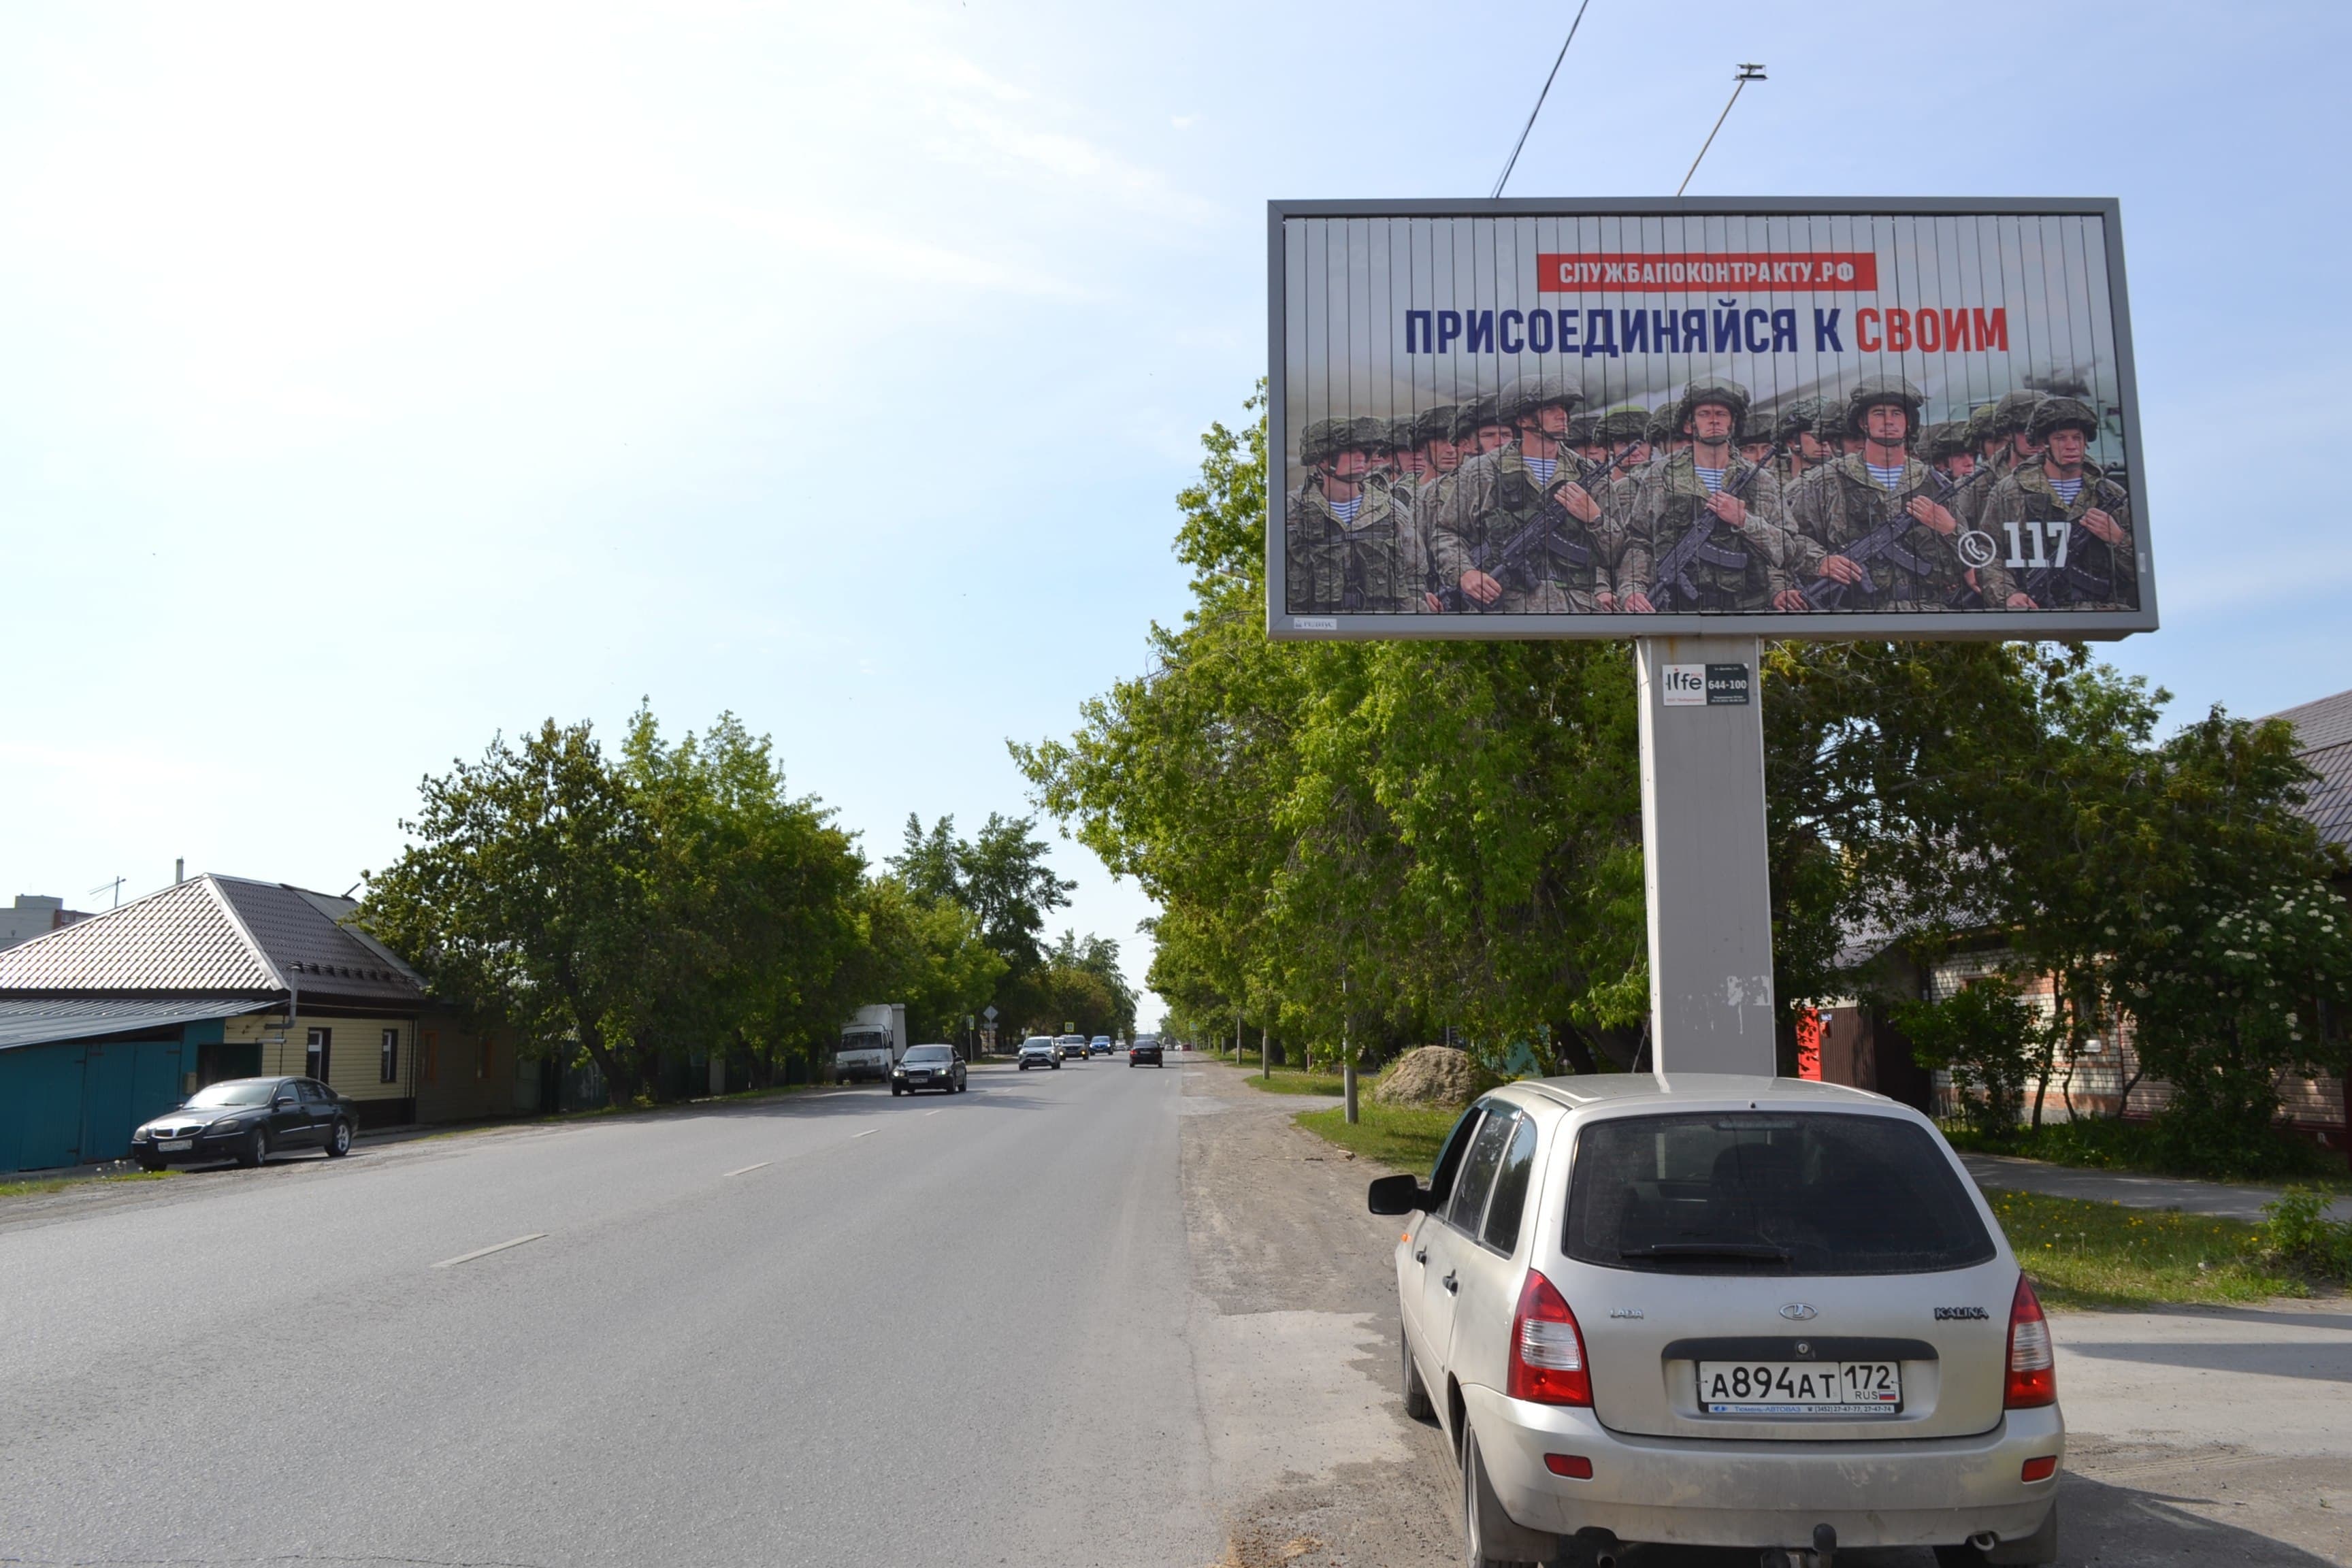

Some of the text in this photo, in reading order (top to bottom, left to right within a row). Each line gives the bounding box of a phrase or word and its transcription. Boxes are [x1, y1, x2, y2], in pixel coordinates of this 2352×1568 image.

[1559, 261, 1855, 284] СЛУЖБАПОКОНТРАКТУ.РФ
[1405, 297, 2009, 358] ПРИСОЕДИНЯЙСЯ К СВОИМ
[2003, 521, 2072, 568] 117
[1708, 680, 1748, 689] 644-100
[1609, 1308, 1644, 1320] LADA
[1934, 1307, 1989, 1320] KALINA
[1844, 1365, 1891, 1390] 172
[1855, 1390, 1878, 1400] RUS
